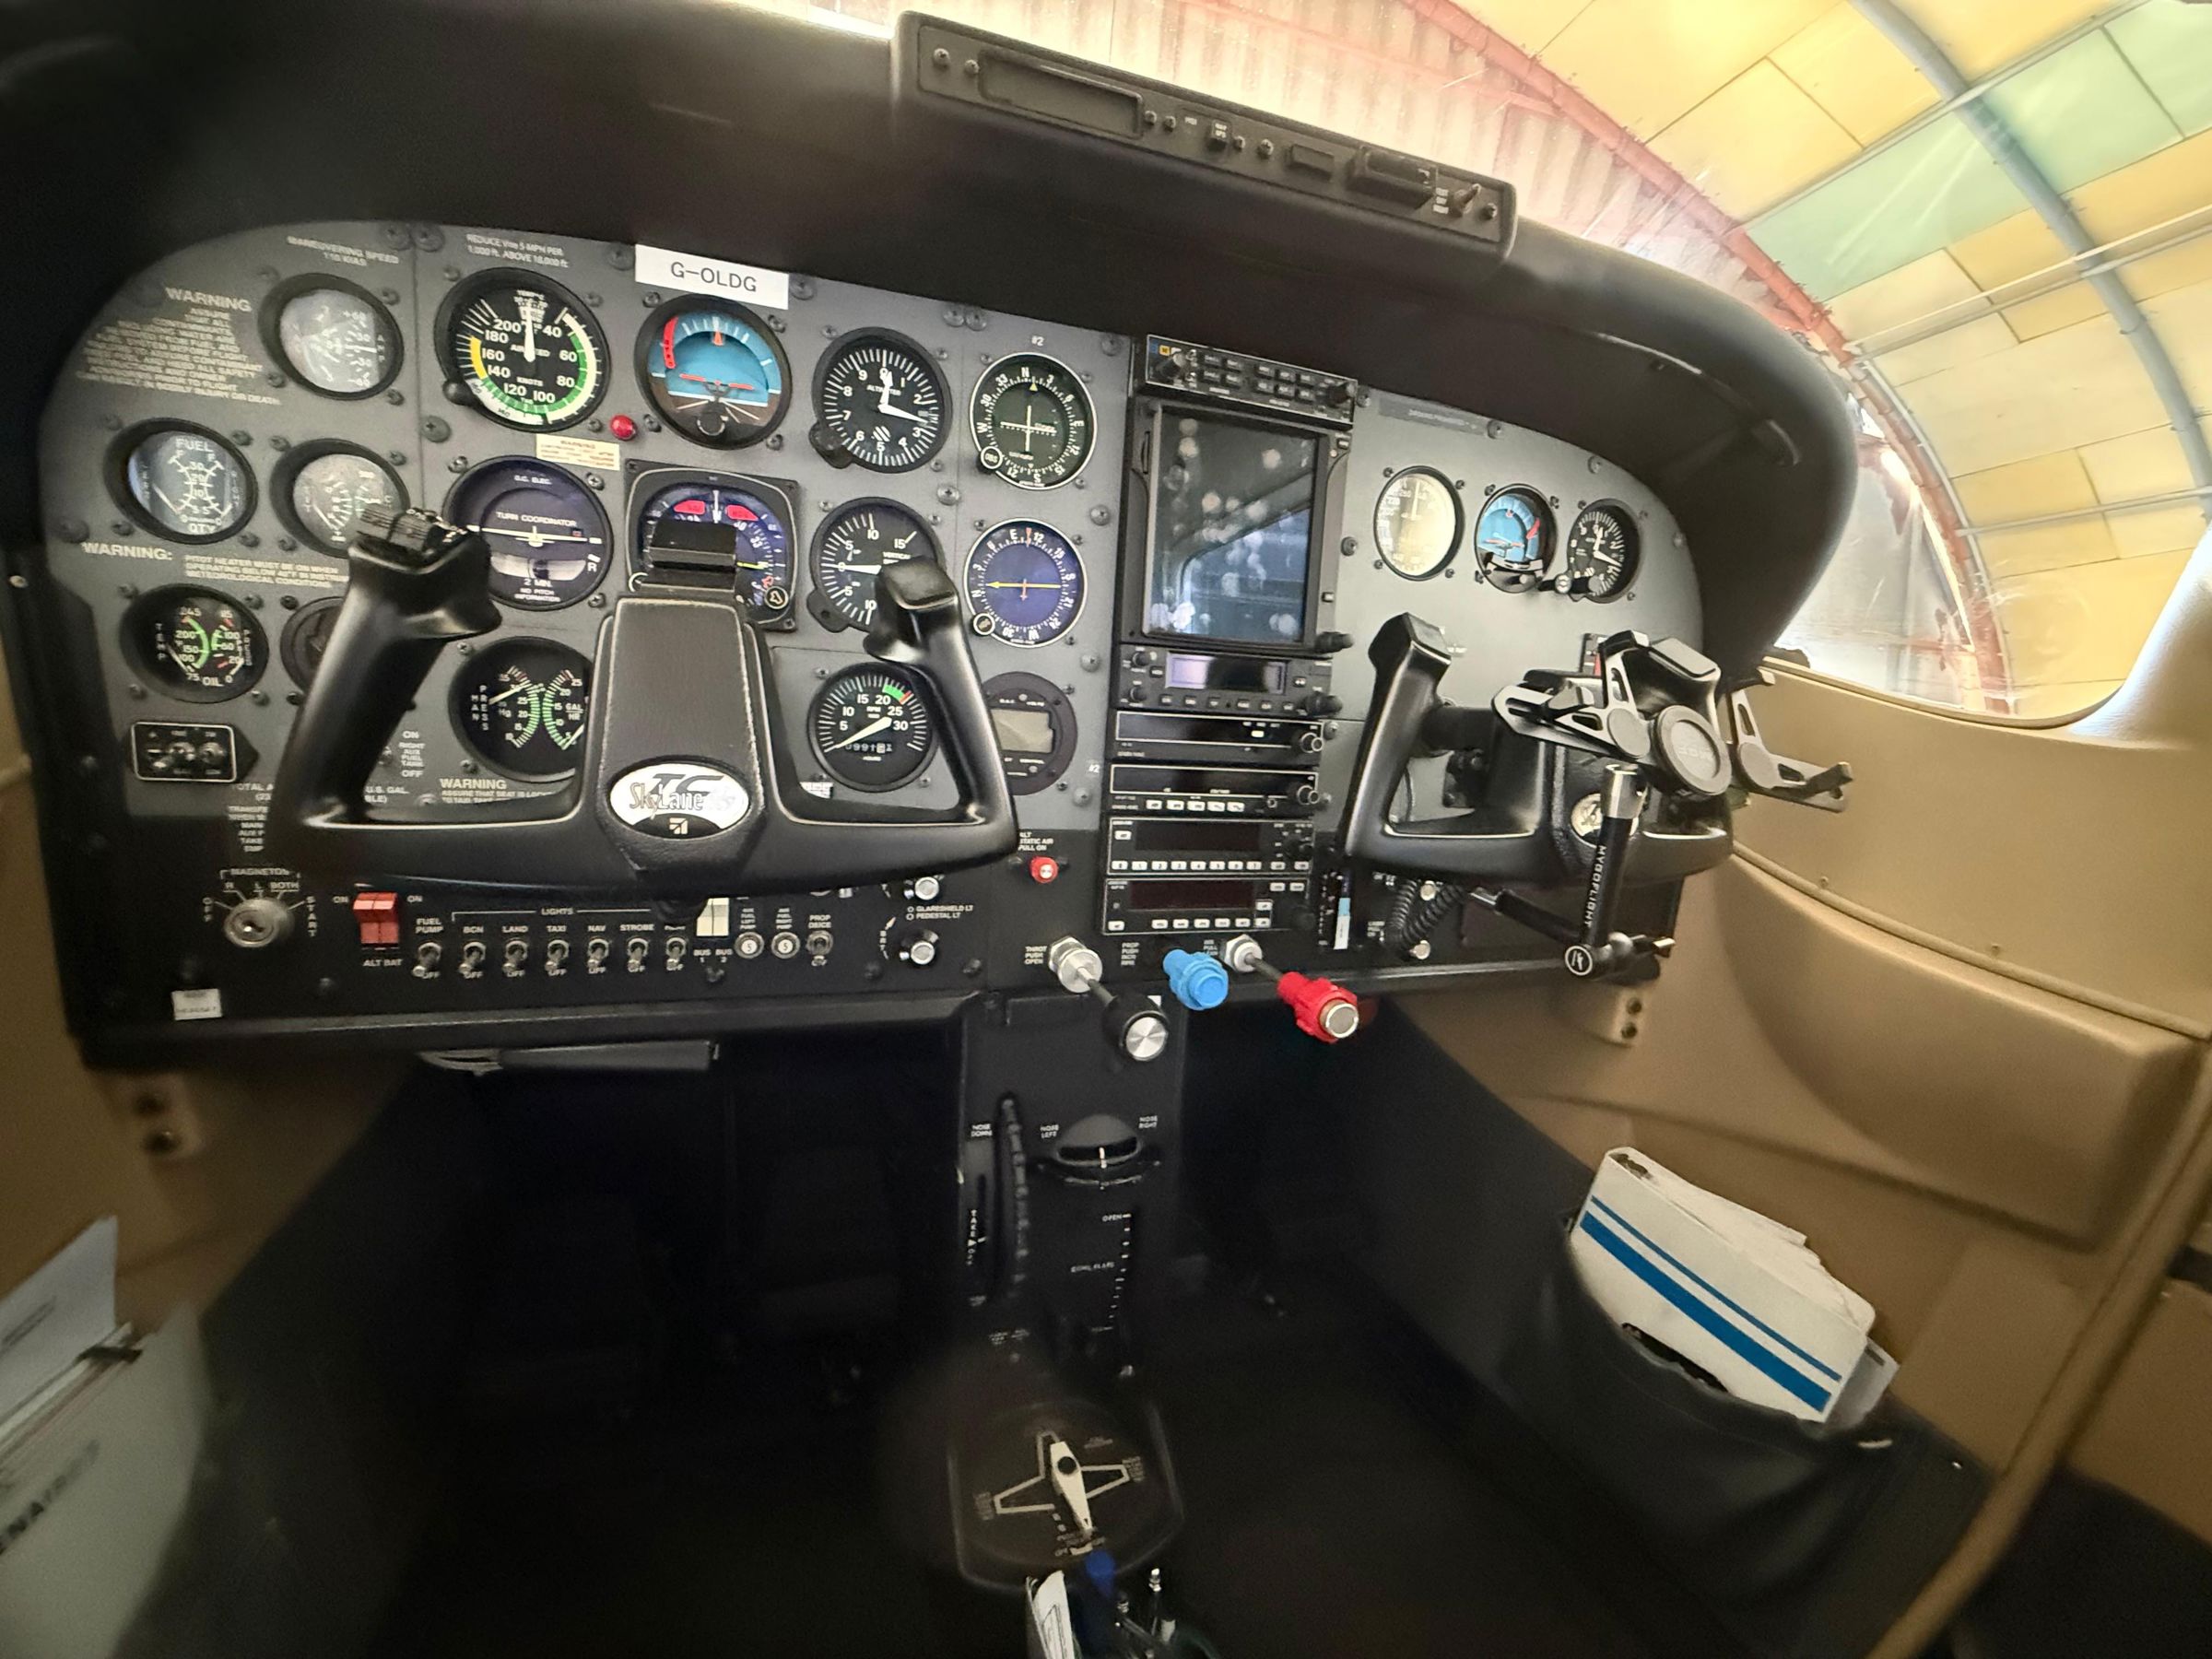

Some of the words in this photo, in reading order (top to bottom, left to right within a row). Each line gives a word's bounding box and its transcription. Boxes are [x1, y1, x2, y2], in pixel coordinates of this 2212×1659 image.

[365, 251, 399, 264] SPEED
[502, 251, 532, 263] ABOVE
[670, 262, 757, 292] G-OLDG
[165, 287, 253, 312] WARNING
[493, 319, 521, 334] 200
[485, 330, 509, 344] 180
[543, 325, 562, 339] 40
[1031, 335, 1044, 346] #2
[482, 347, 504, 361] 160
[559, 350, 577, 363] 60
[488, 365, 511, 378] 140
[858, 371, 868, 381] 9
[1021, 367, 1030, 377] N
[516, 376, 543, 387] KNOTS
[557, 375, 575, 389] 80
[900, 377, 905, 387] 1
[1047, 374, 1054, 383] 3
[504, 382, 527, 396] 120
[843, 386, 853, 396] 8
[533, 391, 556, 403] 100
[913, 394, 923, 404] 2
[1065, 394, 1075, 403] 6
[842, 410, 851, 420] 7
[977, 422, 987, 433] W
[1077, 419, 1085, 428] E
[855, 430, 865, 441] 6
[912, 428, 921, 437] 3
[176, 439, 213, 453] FUEL
[877, 441, 885, 452] 5
[898, 437, 907, 446] 4
[189, 462, 205, 470] 30
[496, 512, 519, 521] TURN
[521, 513, 577, 527] COORDINATOR
[189, 524, 217, 534] QTY
[1010, 529, 1018, 539] E
[867, 530, 879, 540] 10
[1033, 533, 1044, 542] 12
[845, 540, 854, 550] 5
[894, 538, 906, 549] 15
[81, 542, 173, 560] WARNING:
[587, 562, 597, 572] R
[844, 586, 853, 596] 5
[971, 589, 982, 598] N
[865, 600, 877, 610] 10
[175, 630, 196, 639] 200
[1029, 629, 1040, 640] W
[203, 677, 225, 687] OIL
[225, 675, 233, 683] 0
[571, 678, 582, 687] 25
[857, 694, 869, 703] 15
[876, 695, 890, 705] 20
[842, 706, 854, 716] 10
[888, 706, 903, 716] 25
[840, 721, 848, 731] 5
[893, 721, 908, 731] 30
[440, 779, 507, 789] WARNING
[1584, 845, 1607, 928] MYGOFLIGHT
[541, 907, 573, 915] LIGHTS
[306, 896, 317, 937] START
[416, 925, 443, 934] PUMP
[463, 925, 484, 934] BCN
[620, 924, 654, 932] STROBE
[362, 959, 382, 967] ALT
[1102, 1214, 1123, 1222] OPEN
[970, 1210, 978, 1237] TAKE
